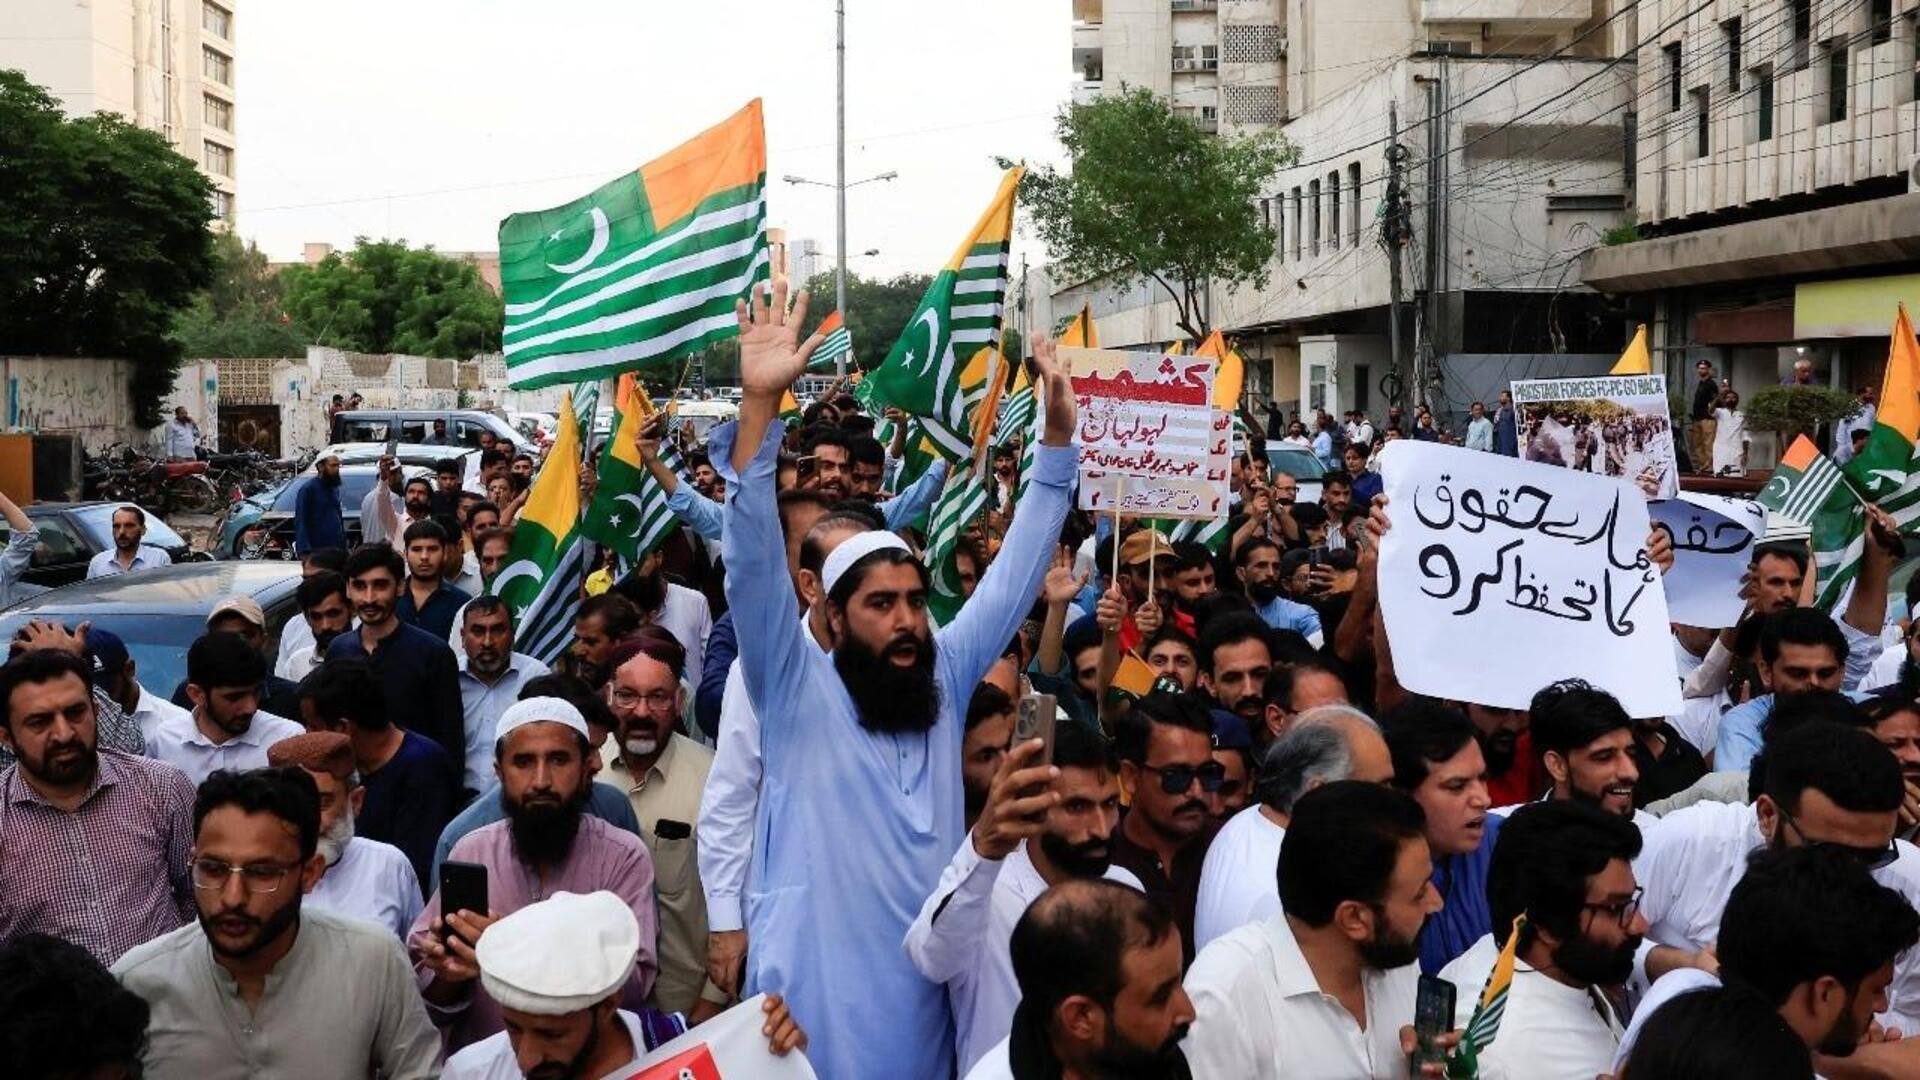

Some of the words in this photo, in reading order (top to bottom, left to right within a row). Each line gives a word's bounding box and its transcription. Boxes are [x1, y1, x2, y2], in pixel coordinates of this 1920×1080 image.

[1071, 357, 1210, 409] کشمی
[1560, 381, 1596, 399] FORCES
[1624, 379, 1637, 396] GO
[1638, 377, 1664, 395] BACK
[1413, 473, 1554, 534] حقوق
[1505, 554, 1598, 622] تحفظ
[1604, 568, 1646, 637] کا
